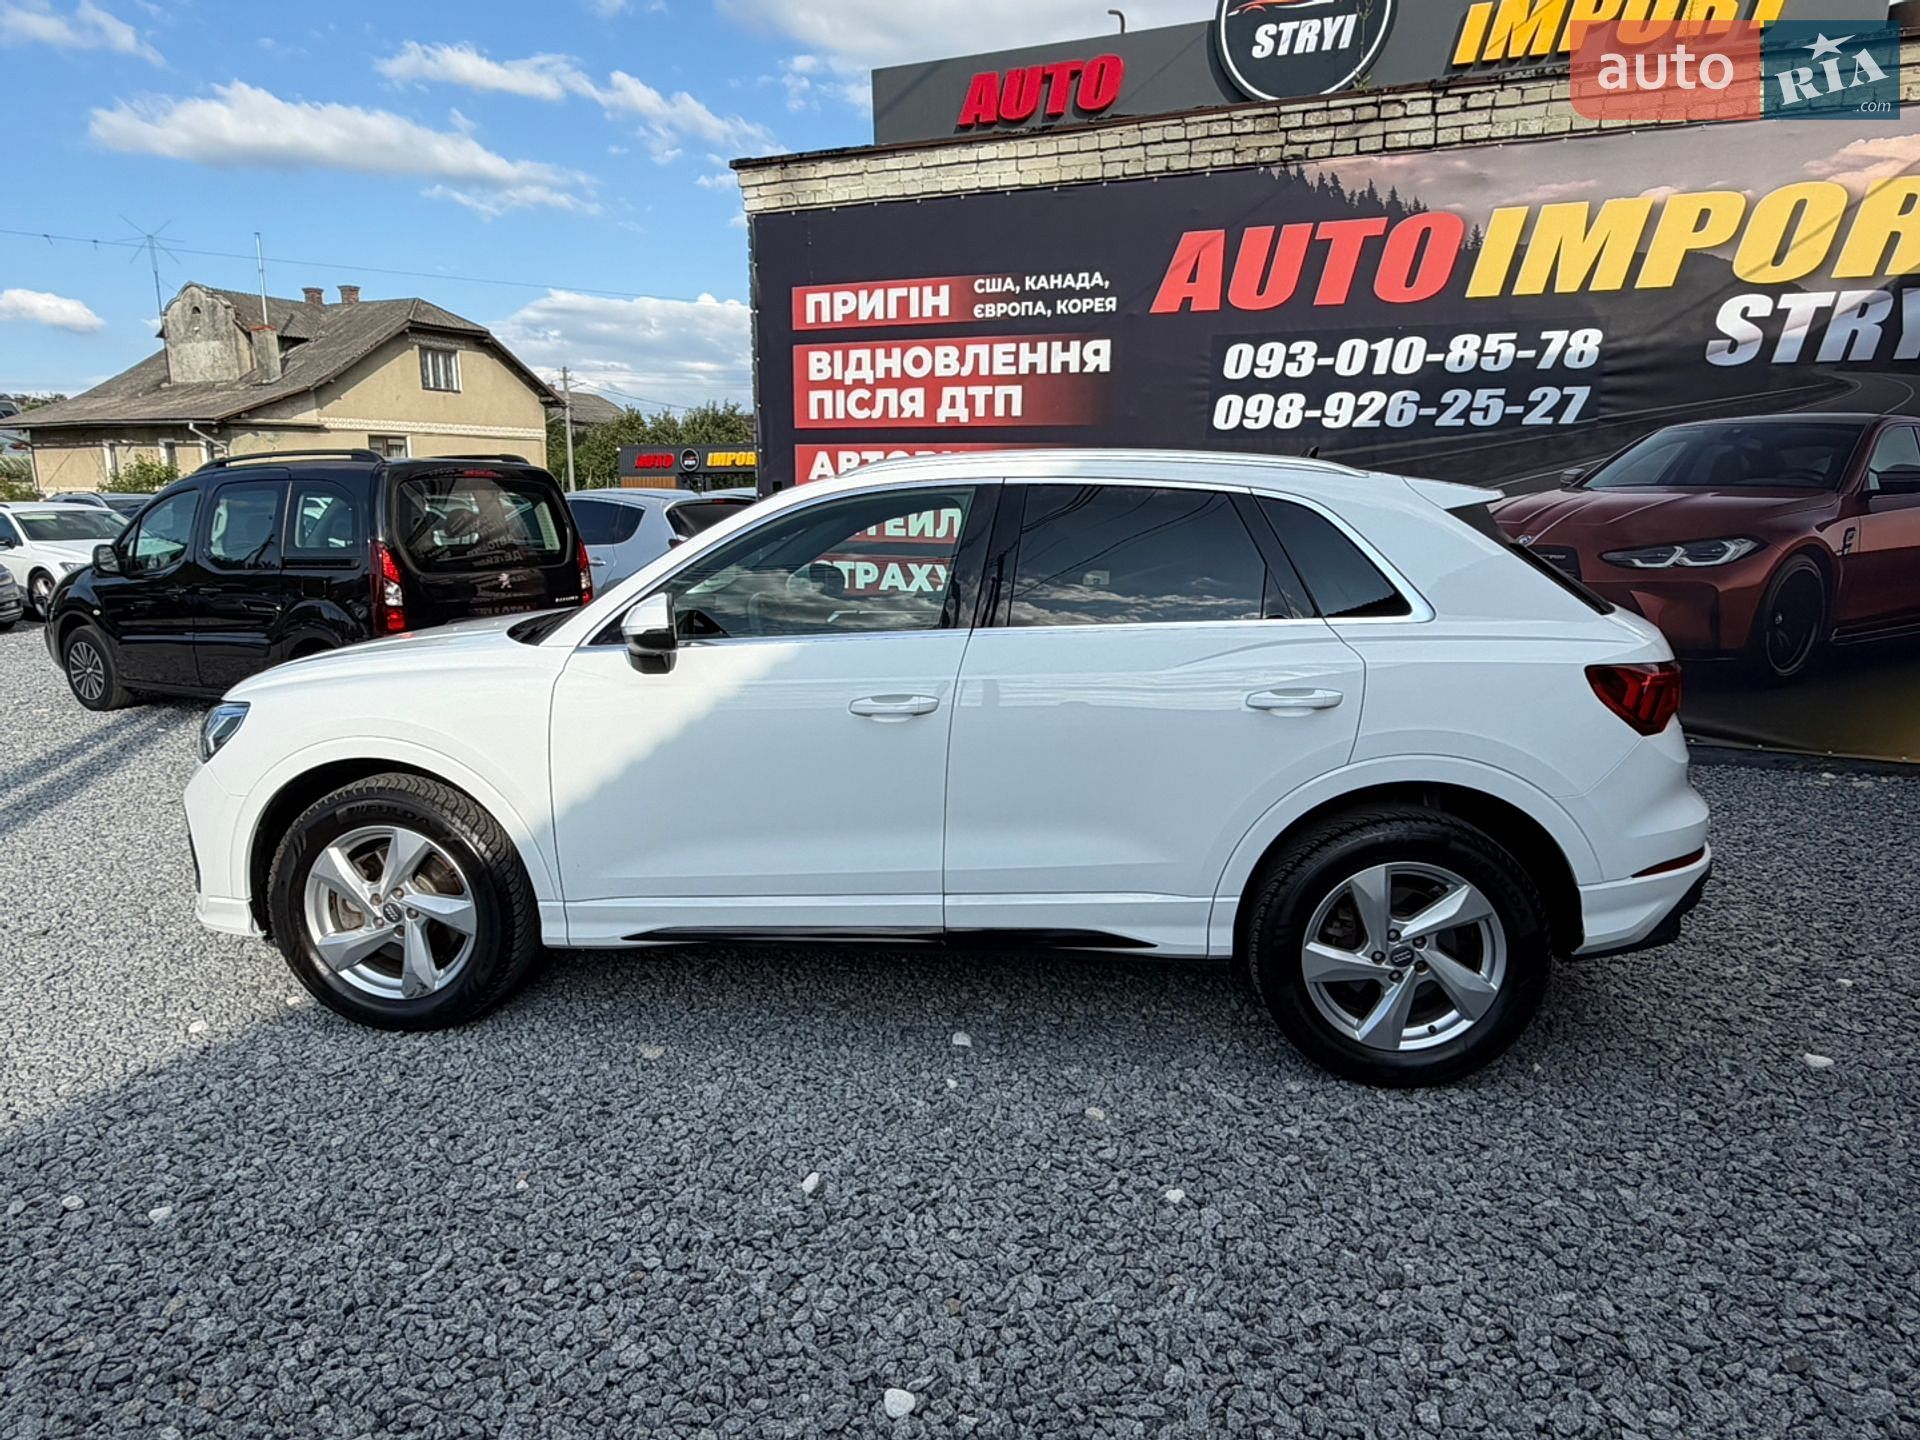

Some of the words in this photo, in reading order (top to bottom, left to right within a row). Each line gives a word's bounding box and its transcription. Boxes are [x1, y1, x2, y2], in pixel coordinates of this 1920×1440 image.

[1251, 13, 1358, 59] STRYI
[958, 54, 1125, 127] AUTO
[804, 284, 951, 325] ПРИГІН
[973, 277, 1021, 294] США,
[1024, 271, 1111, 291] КАНАДА,
[973, 300, 1053, 318] ЄВРОПА,
[1056, 296, 1118, 315] КОРЕЯ
[807, 338, 1113, 385] ВІДНОВЛЕННЯ
[1222, 327, 1604, 380] 093-010-85-78
[807, 386, 926, 421] ПІСЛЯ
[935, 384, 1024, 424] ДТП
[1212, 386, 1592, 431] 098-926-25-27
